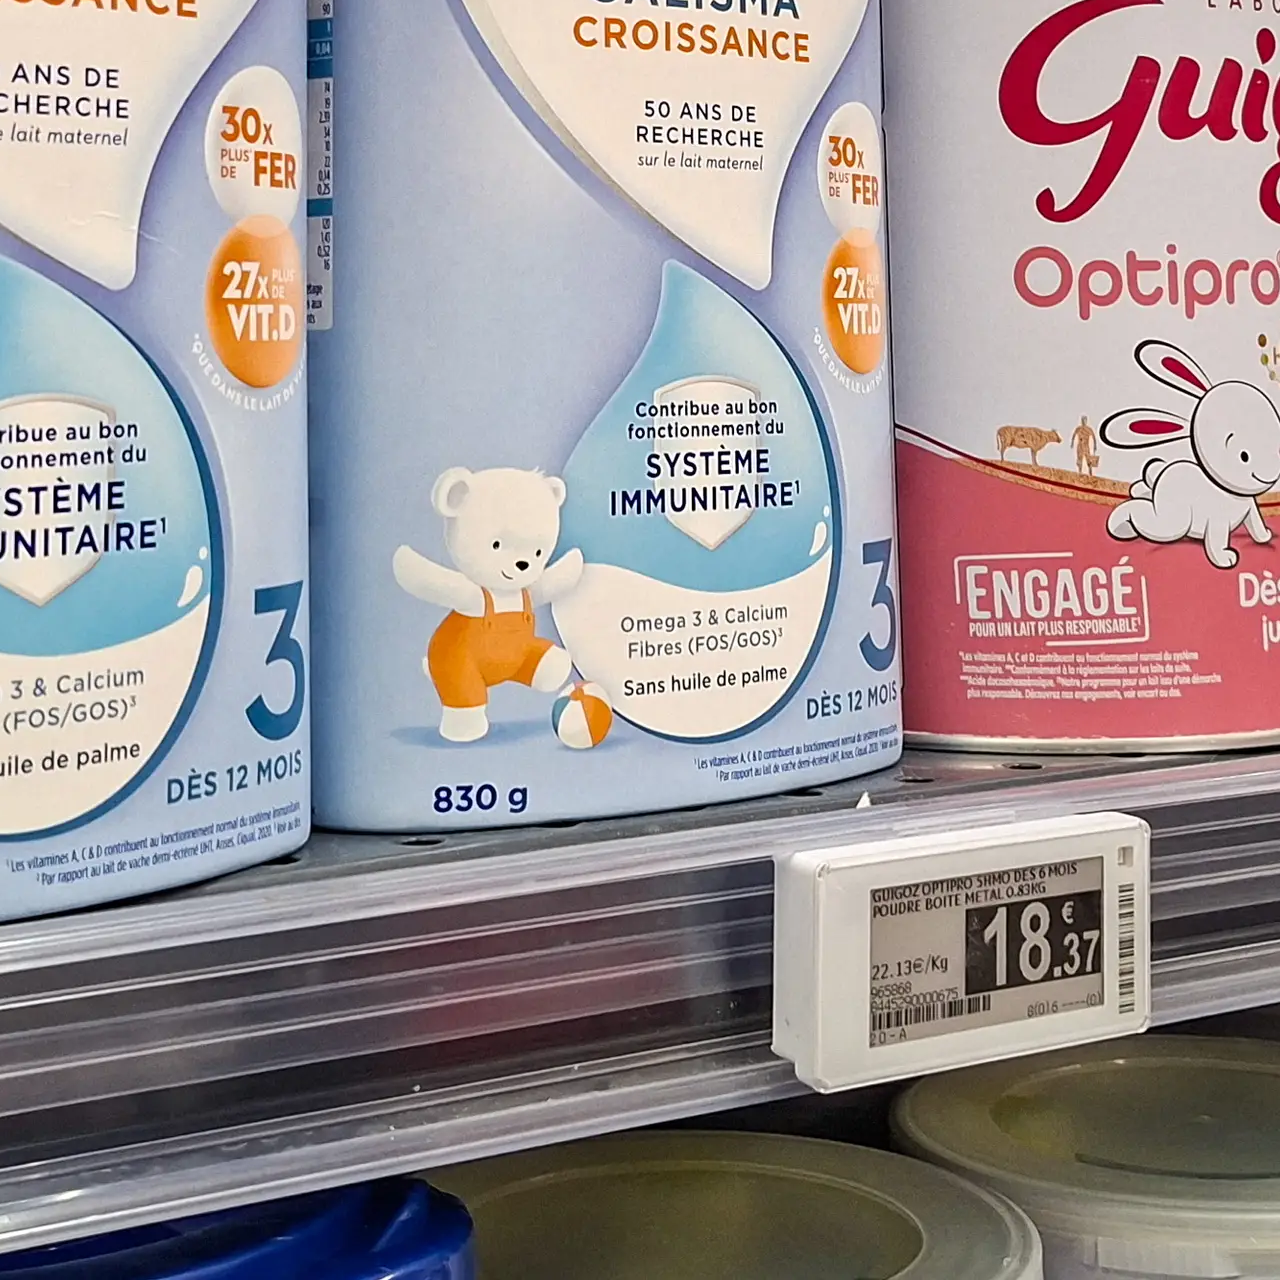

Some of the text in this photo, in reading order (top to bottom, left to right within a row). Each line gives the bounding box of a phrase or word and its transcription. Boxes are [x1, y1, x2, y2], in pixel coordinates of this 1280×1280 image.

[572, 16, 811, 64] CROISSANCE
[646, 444, 771, 480] SYSTÈME
[859, 538, 895, 672] 3
[966, 555, 1137, 620] ENGAGÉ
[245, 580, 306, 742] 3
[167, 749, 303, 807] DÈS 12 MOIS
[432, 784, 529, 814] 830 g
[872, 861, 1077, 902] GUIGOZ OPTIPRO MOIS
[872, 882, 1046, 919] POUDRE BOITE METAL 0.83KG
[1062, 901, 1075, 925] €
[872, 955, 948, 980] 22.13€/Kg
